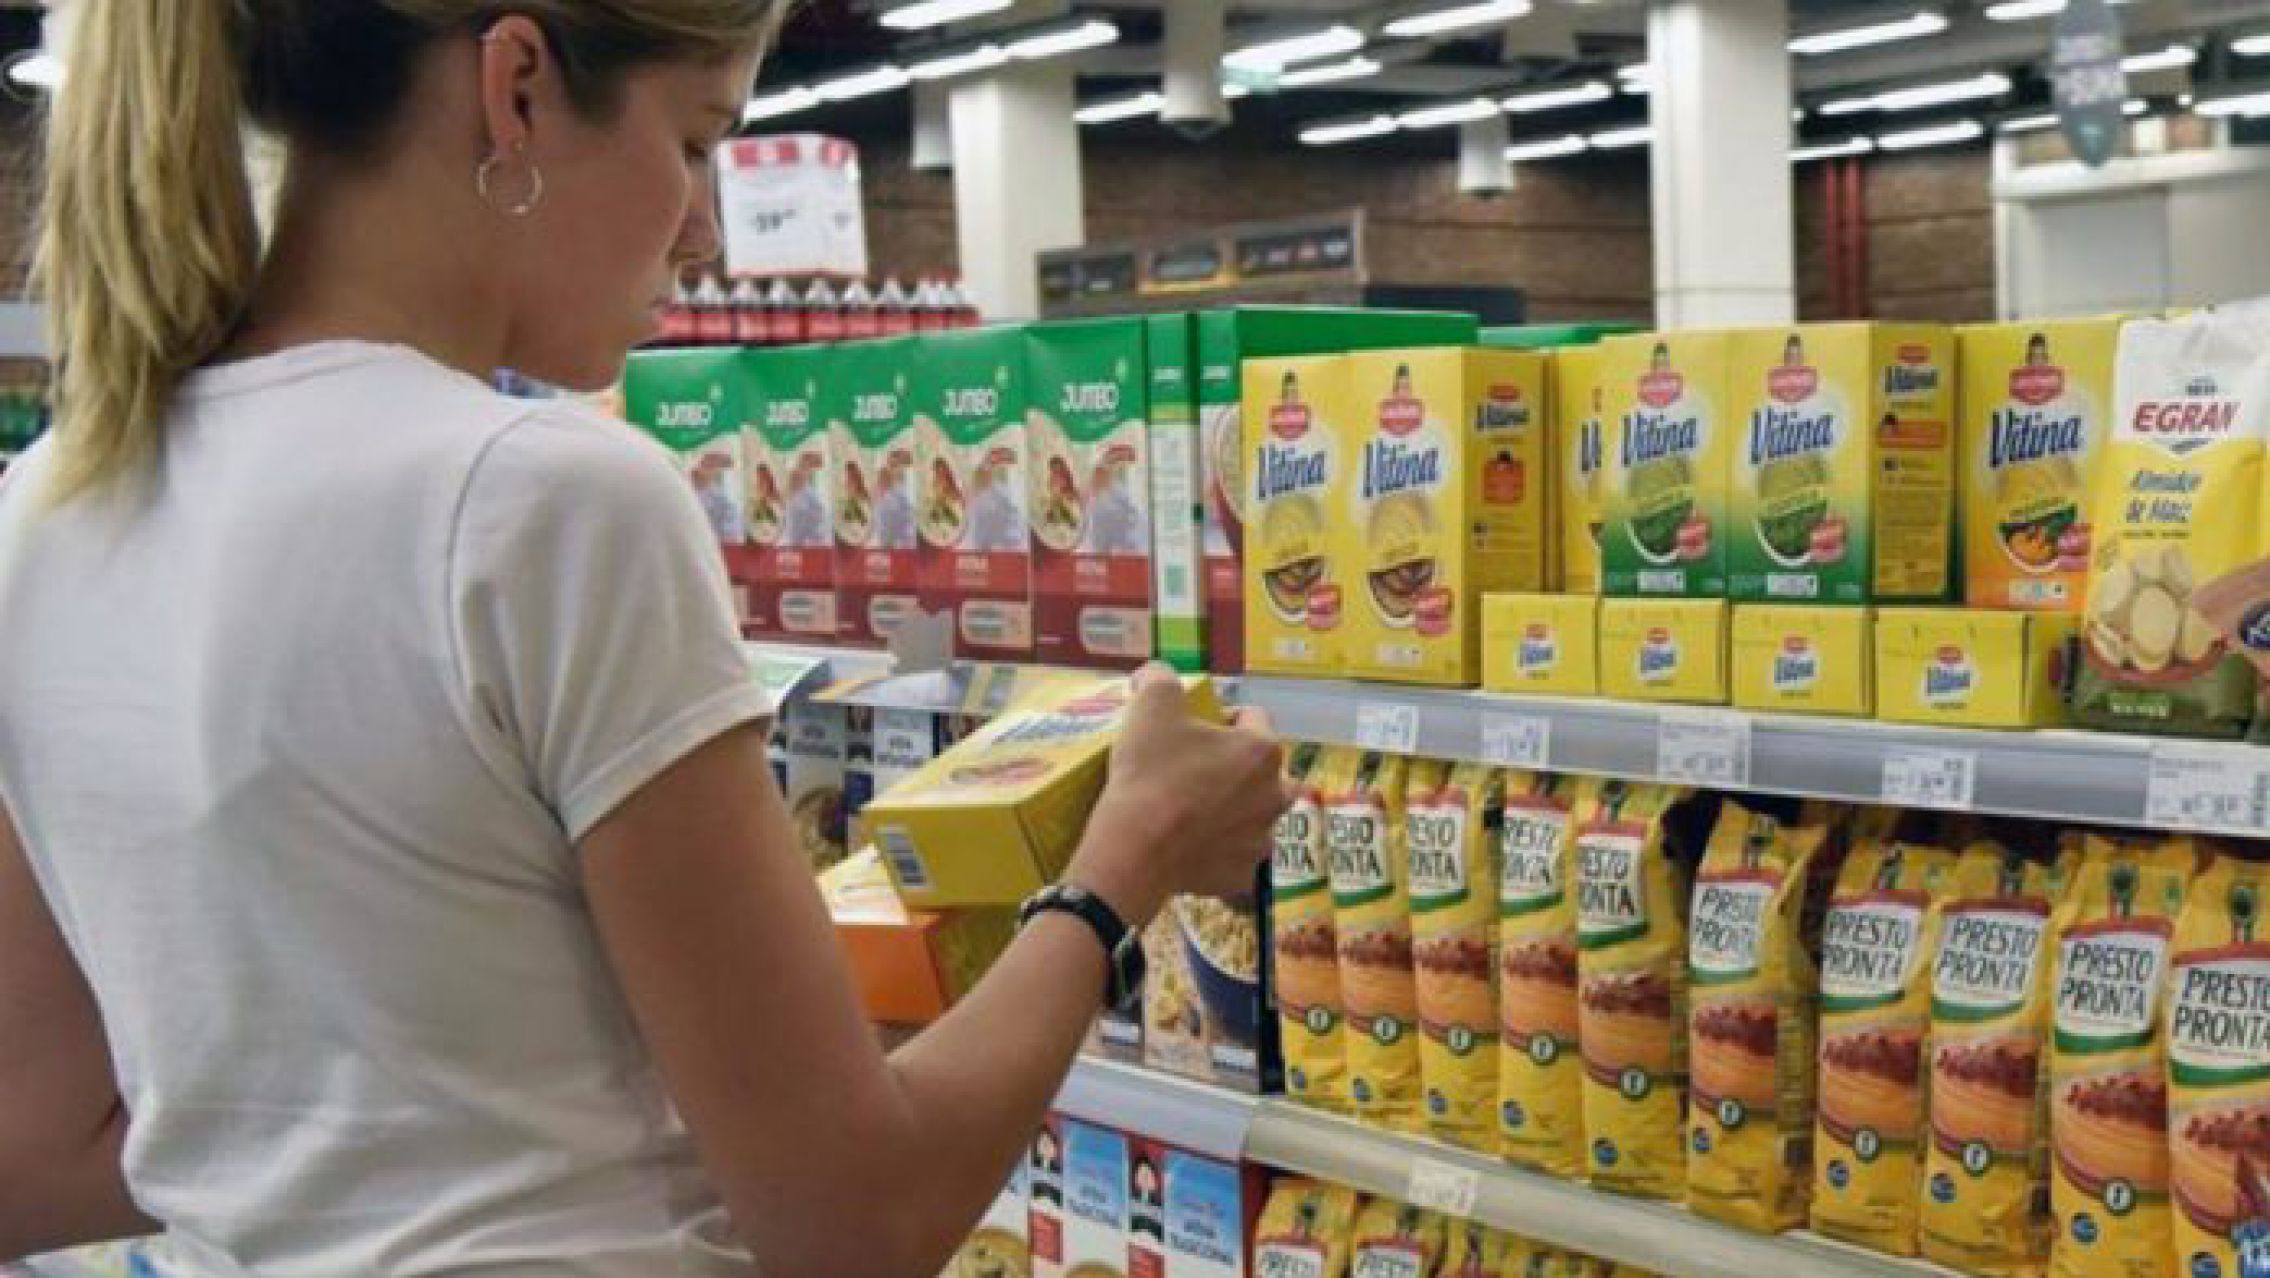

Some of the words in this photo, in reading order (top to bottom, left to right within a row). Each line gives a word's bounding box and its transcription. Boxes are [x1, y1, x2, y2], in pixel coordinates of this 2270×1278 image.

[656, 402, 711, 427] JUMBO
[767, 400, 808, 425] JUMBO
[854, 395, 898, 422] JUMBO
[942, 388, 996, 415] JUMBO
[1060, 383, 1119, 412] JUMBO
[1621, 409, 1696, 466] Vitina
[1750, 406, 1834, 464] Vitina
[1990, 408, 2083, 468] Vitina
[1257, 442, 1326, 499] Vitina
[1363, 438, 1439, 498] Vitina
[1579, 883, 1634, 917] ONTA
[2068, 942, 2154, 983] PRESTO
[2059, 977, 2145, 1020] PRONTA
